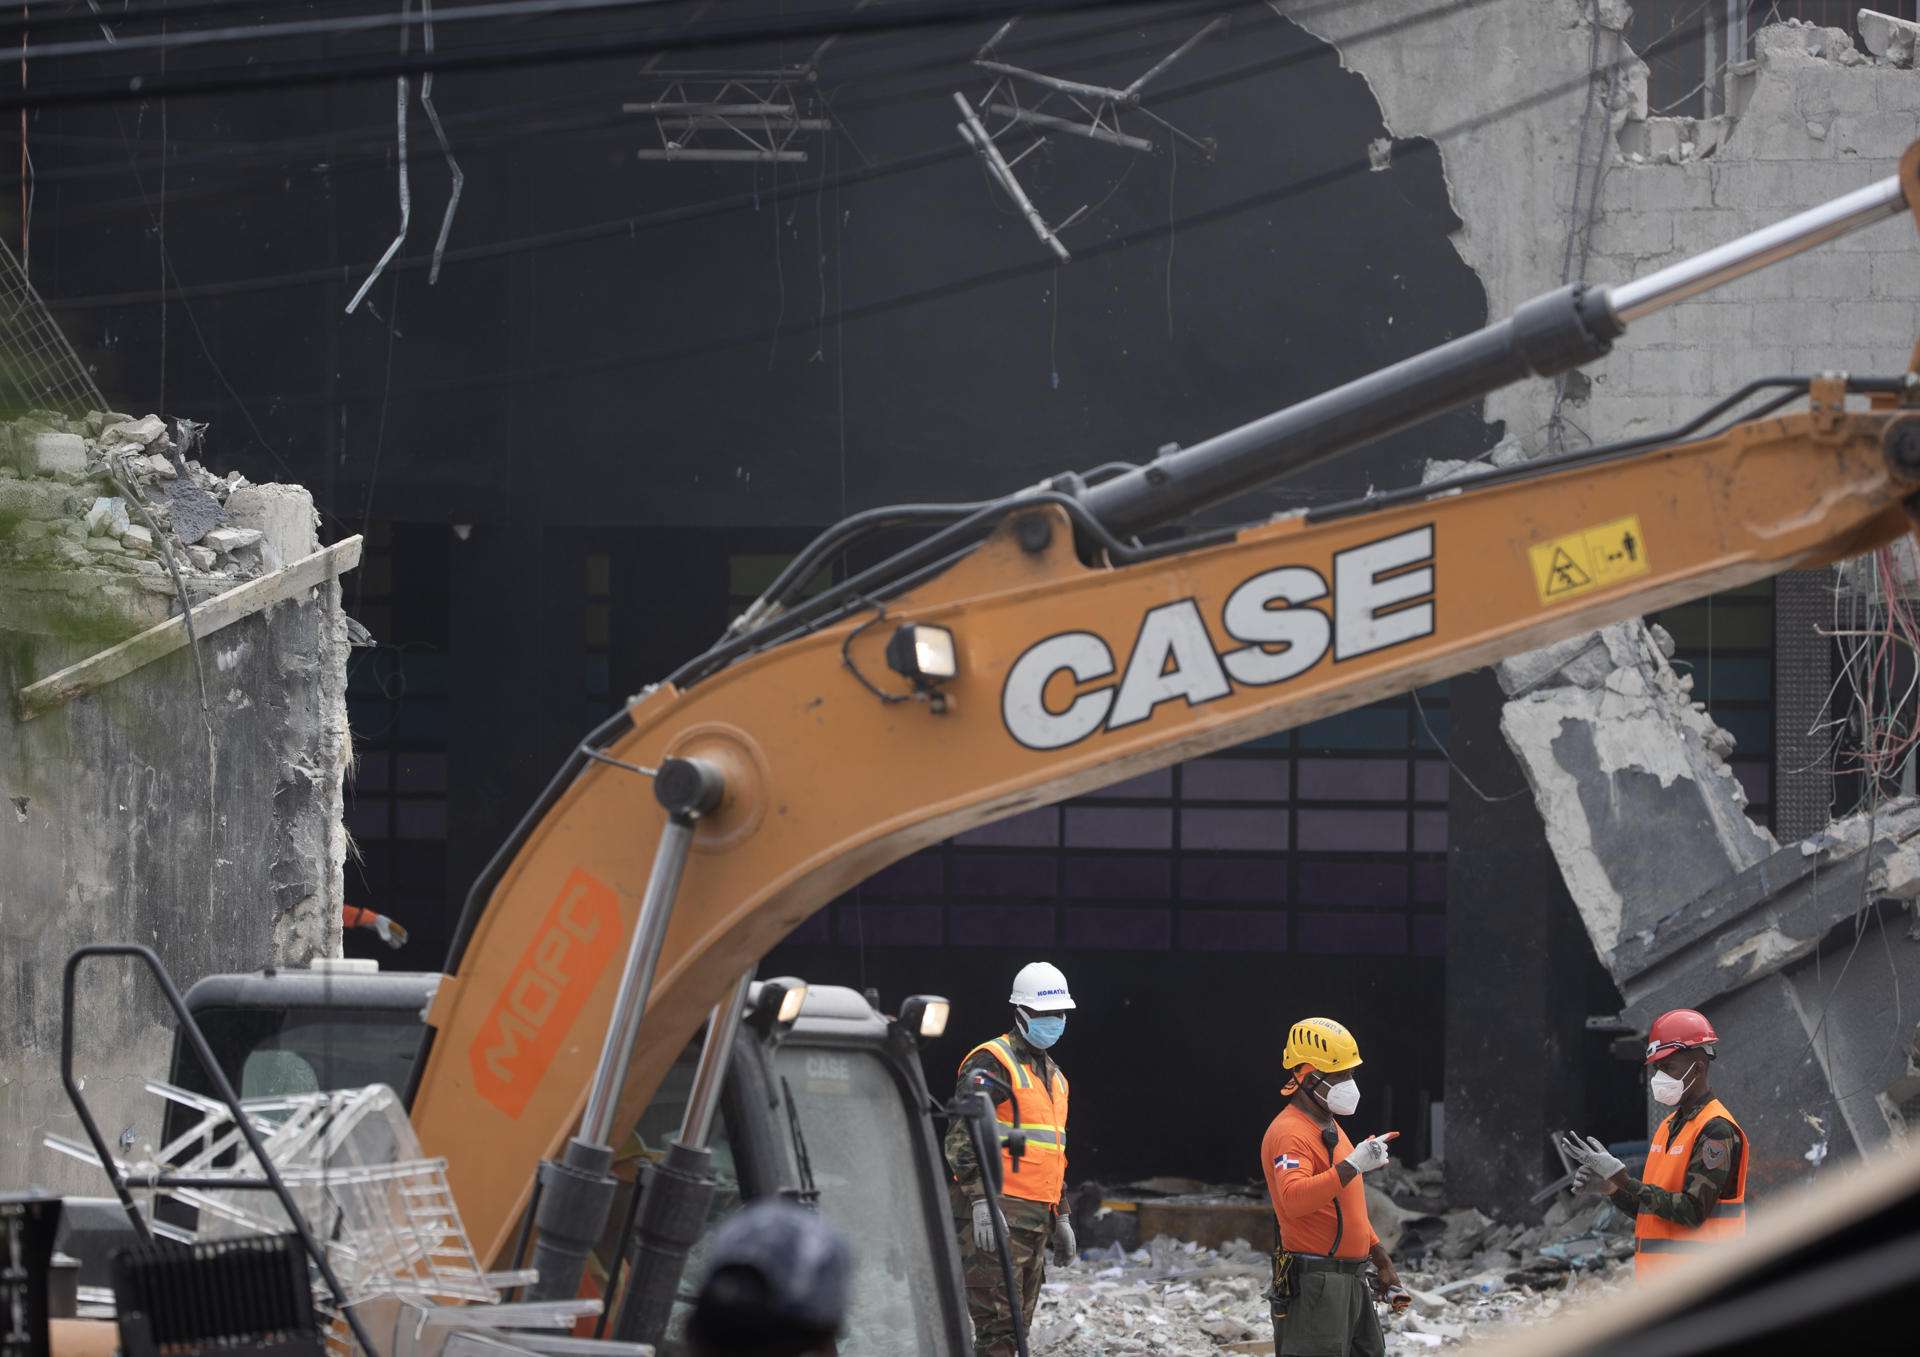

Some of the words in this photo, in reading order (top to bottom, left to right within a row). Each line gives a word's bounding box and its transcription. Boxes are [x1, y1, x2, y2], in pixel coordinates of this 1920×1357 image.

[1001, 523, 1435, 751] CASE
[483, 882, 603, 1085] MOPC
[806, 1057, 849, 1080] CASE
